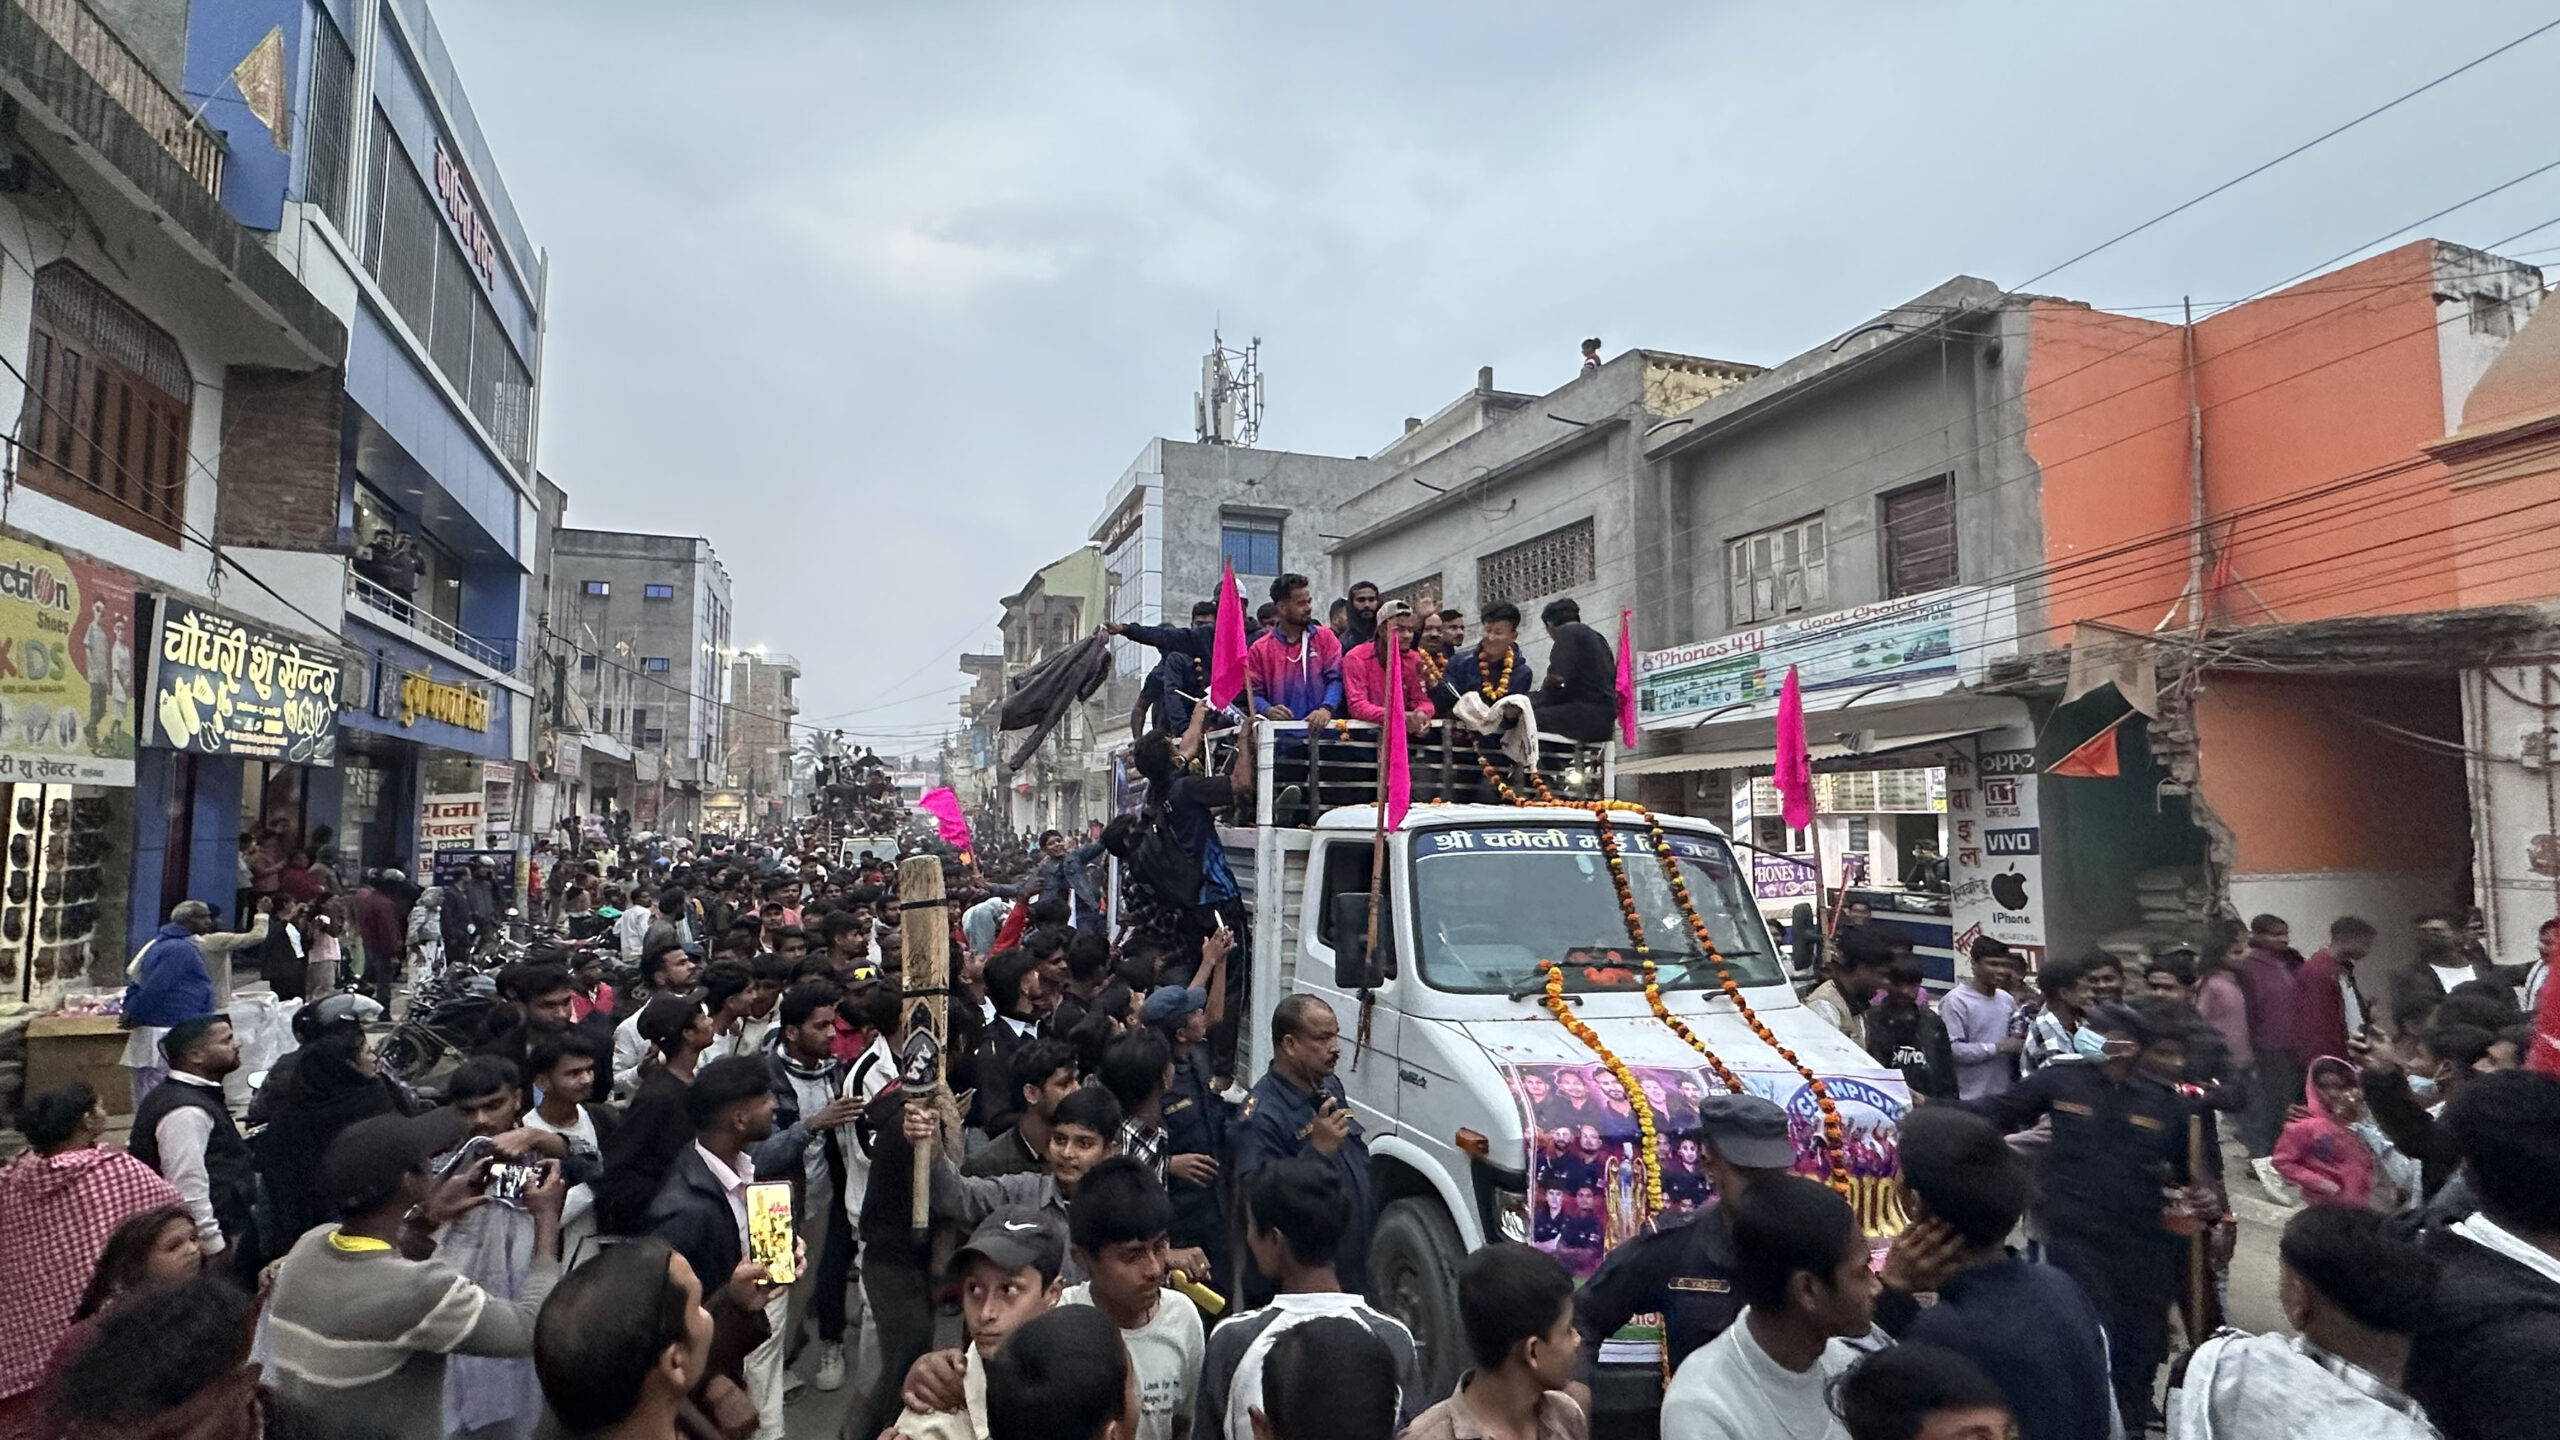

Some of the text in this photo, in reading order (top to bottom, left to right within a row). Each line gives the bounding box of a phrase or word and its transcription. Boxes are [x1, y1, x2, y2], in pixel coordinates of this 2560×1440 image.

[0, 560, 70, 611] ction
[36, 611, 69, 635] Shoes
[1799, 612, 1845, 632] Good
[1853, 598, 1918, 620] Choice
[1654, 643, 1728, 669] Phones
[36, 757, 77, 777] सेन्टर
[1982, 753, 2035, 771] OPPO
[438, 841, 470, 849] OPPO
[1434, 831, 1474, 851] श्री
[1484, 829, 1570, 850] चमेली
[1576, 833, 1628, 852] मई
[1987, 832, 2031, 850] VIVO
[1797, 865, 1805, 880] 4
